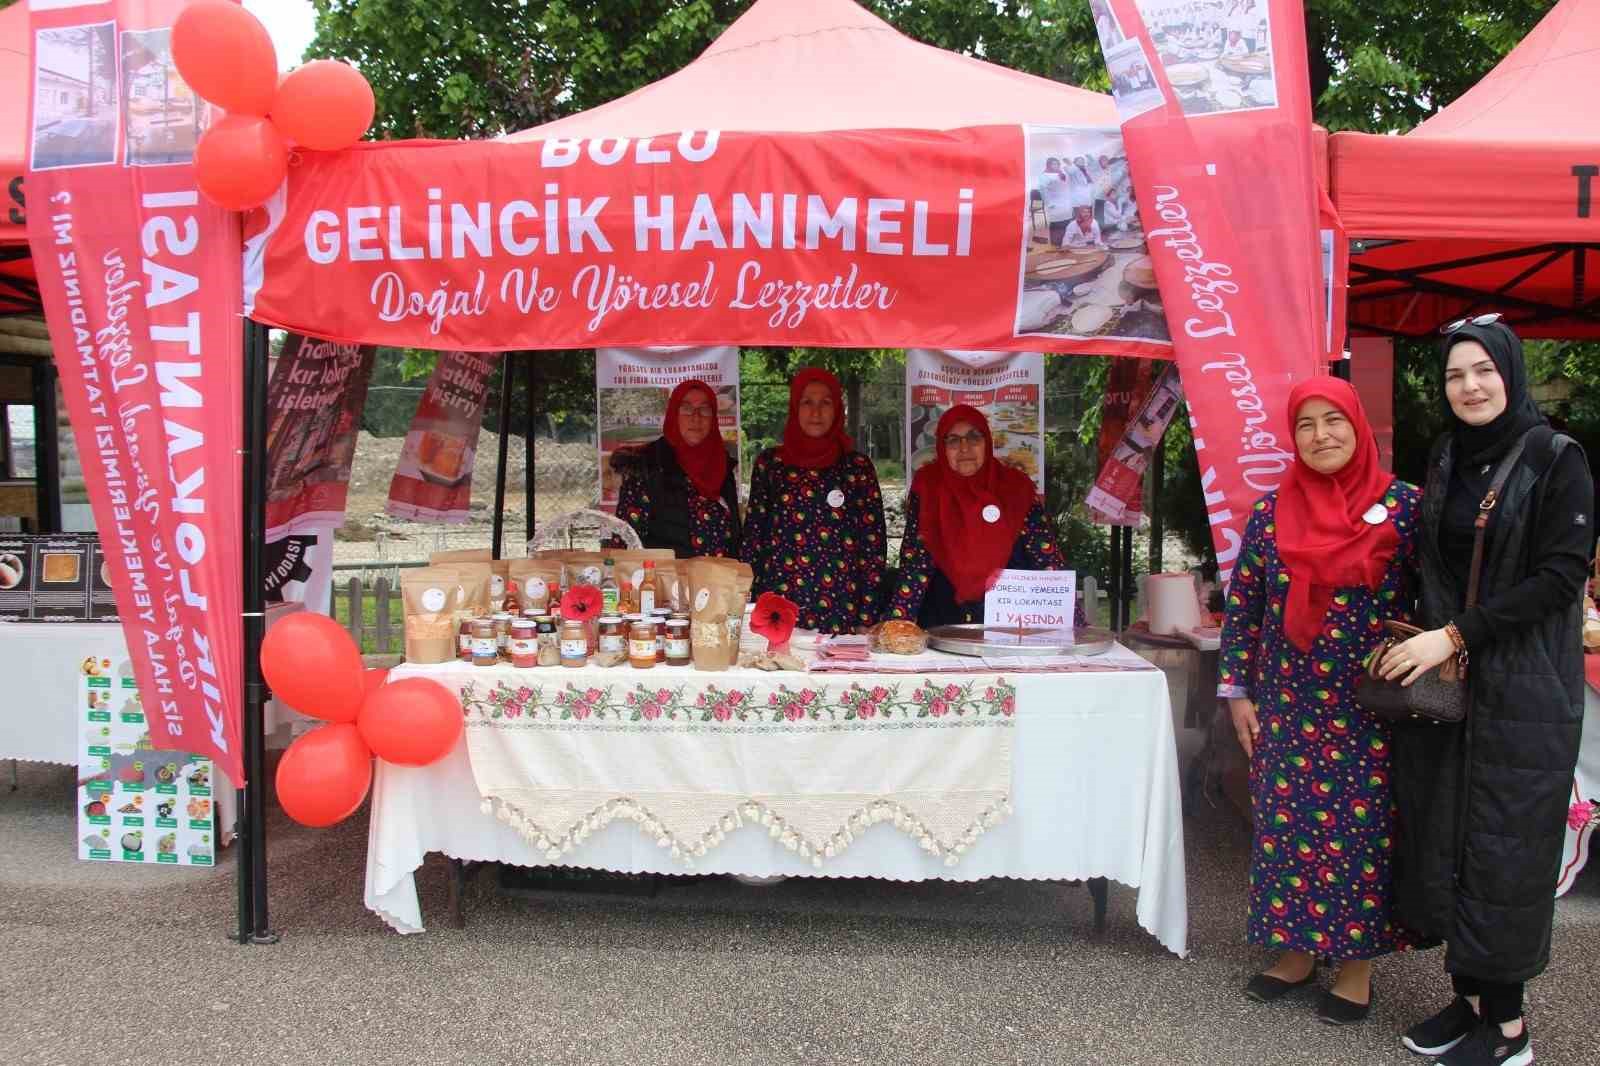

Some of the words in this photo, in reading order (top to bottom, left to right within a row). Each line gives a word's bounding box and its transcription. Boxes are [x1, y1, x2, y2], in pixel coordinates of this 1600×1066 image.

[304, 183, 614, 264] GELİNCİK
[633, 188, 974, 257] HANIMELİ
[1147, 185, 1240, 338] Lezzetler
[370, 269, 489, 335] Doğal
[500, 267, 562, 314] Ve
[572, 260, 718, 332] Yöresel
[729, 259, 898, 329] Lezzetler
[1202, 352, 1295, 491] Yöresel
[277, 540, 302, 577] ODASI
